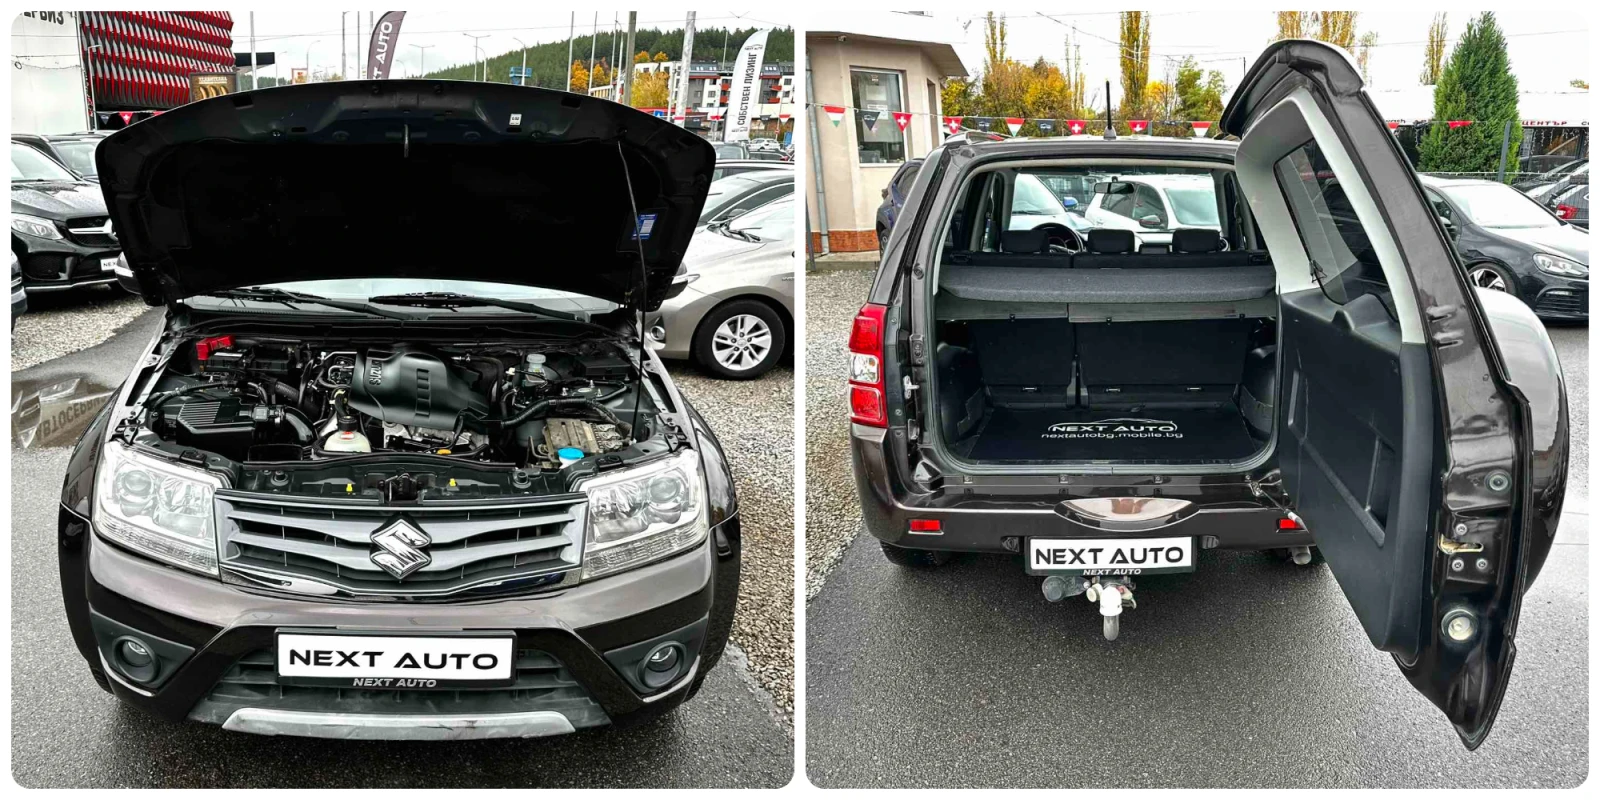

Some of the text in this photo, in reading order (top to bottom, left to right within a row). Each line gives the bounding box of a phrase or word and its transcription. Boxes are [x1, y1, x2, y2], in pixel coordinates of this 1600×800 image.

[375, 21, 393, 64] AUTO
[737, 86, 751, 125] СОБСТВЕН
[744, 52, 757, 84] ЛИЗИНГ
[1035, 546, 1184, 565] NEXT AUTO
[289, 648, 499, 670] NEXT AUTO
[353, 678, 437, 688] NEXT AUTO
